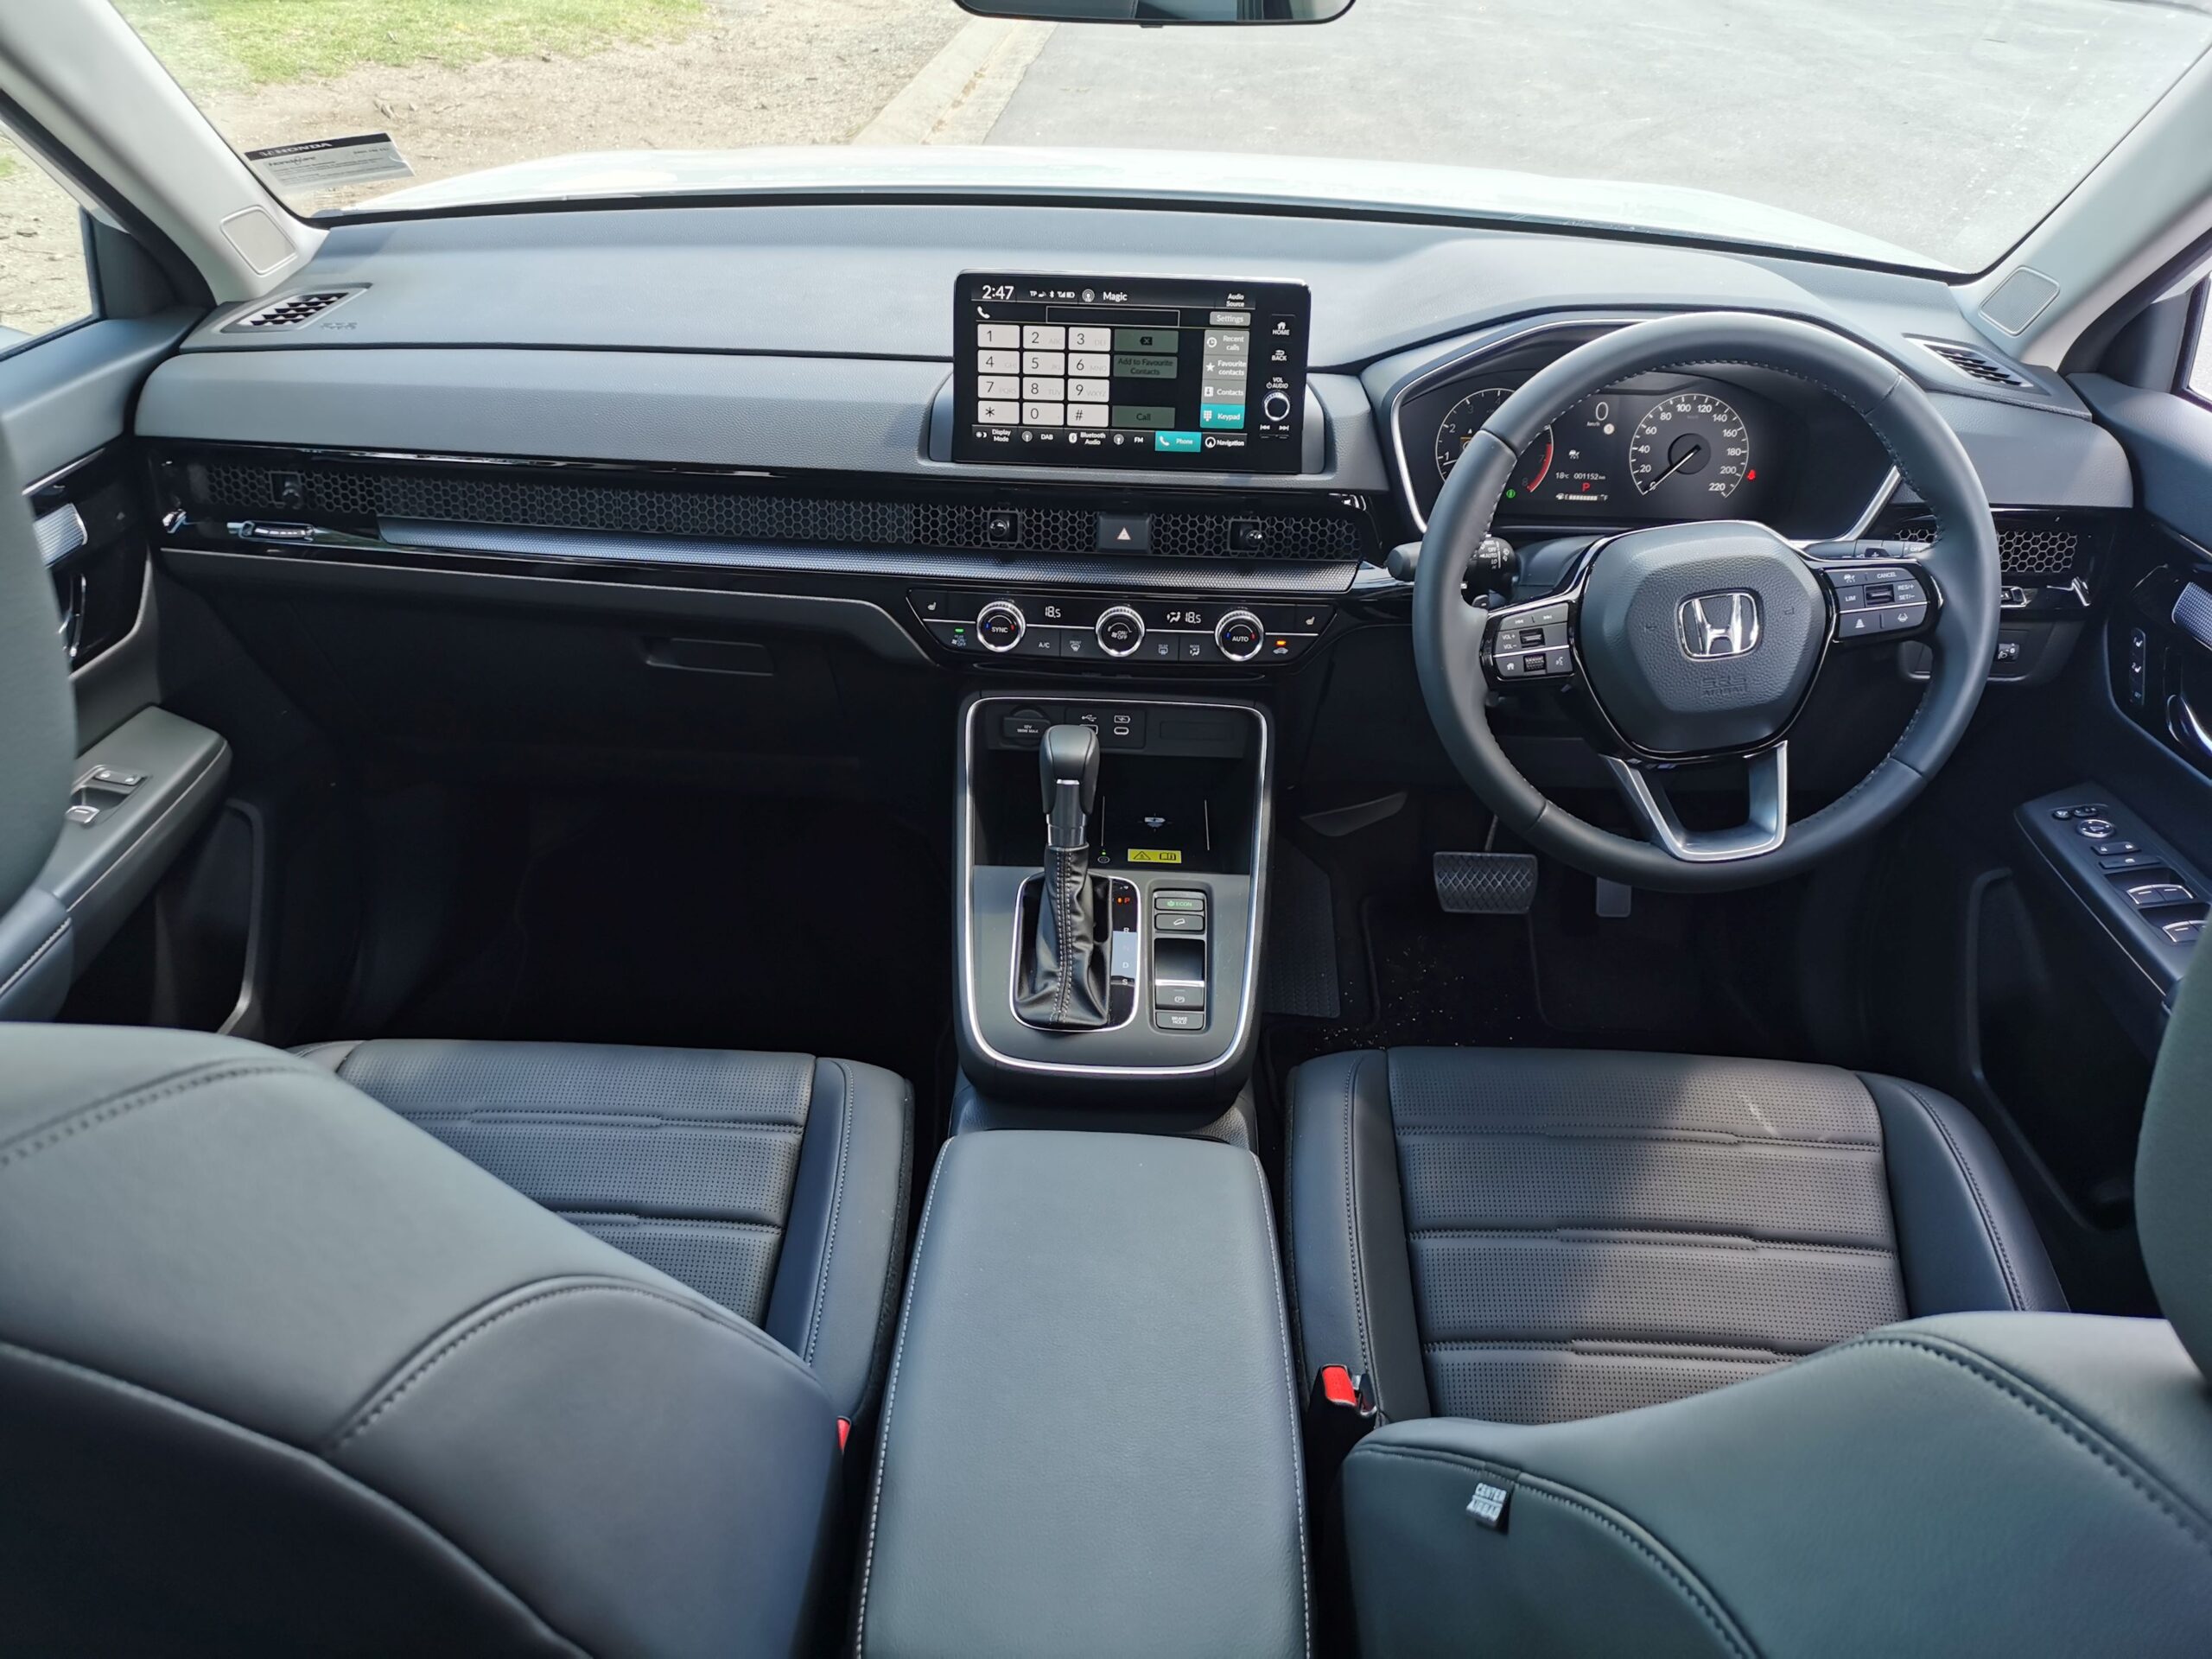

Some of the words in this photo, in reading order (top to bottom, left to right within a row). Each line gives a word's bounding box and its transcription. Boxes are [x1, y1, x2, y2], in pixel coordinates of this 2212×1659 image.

[274, 142, 333, 155] HONDA
[982, 285, 1014, 300] 2:47
[1103, 291, 1128, 302] Magic
[1217, 314, 1244, 324] Settings
[987, 330, 992, 342] 1
[1032, 331, 1039, 344] 2
[1077, 333, 1085, 346] 3
[985, 356, 994, 368] 4
[1031, 357, 1039, 370] 5
[1076, 359, 1084, 371] 6
[1130, 367, 1160, 376] Contacts
[986, 381, 995, 393] 7
[1031, 383, 1039, 395] 8
[1076, 384, 1084, 396] 9
[1595, 402, 1609, 421] 0
[1676, 404, 1691, 412] 100
[1697, 404, 1713, 413] 120
[1030, 408, 1039, 420] 0
[1075, 410, 1083, 421] #
[1136, 412, 1151, 422] Call
[1217, 413, 1241, 422] Keypad
[1660, 412, 1672, 421] 80
[1713, 414, 1727, 423] 140
[1449, 423, 1456, 433] 2
[1645, 426, 1657, 435] 60
[1723, 429, 1738, 437] 160
[1217, 439, 1245, 448] Navigation
[1638, 445, 1650, 454] 40
[1726, 448, 1741, 456] 180
[1445, 451, 1450, 461] 1
[1640, 465, 1652, 474] 20
[1719, 466, 1737, 474] 200
[1582, 482, 1591, 492] P
[1045, 606, 1061, 619] 18.5
[1185, 611, 1201, 624] 18.5
